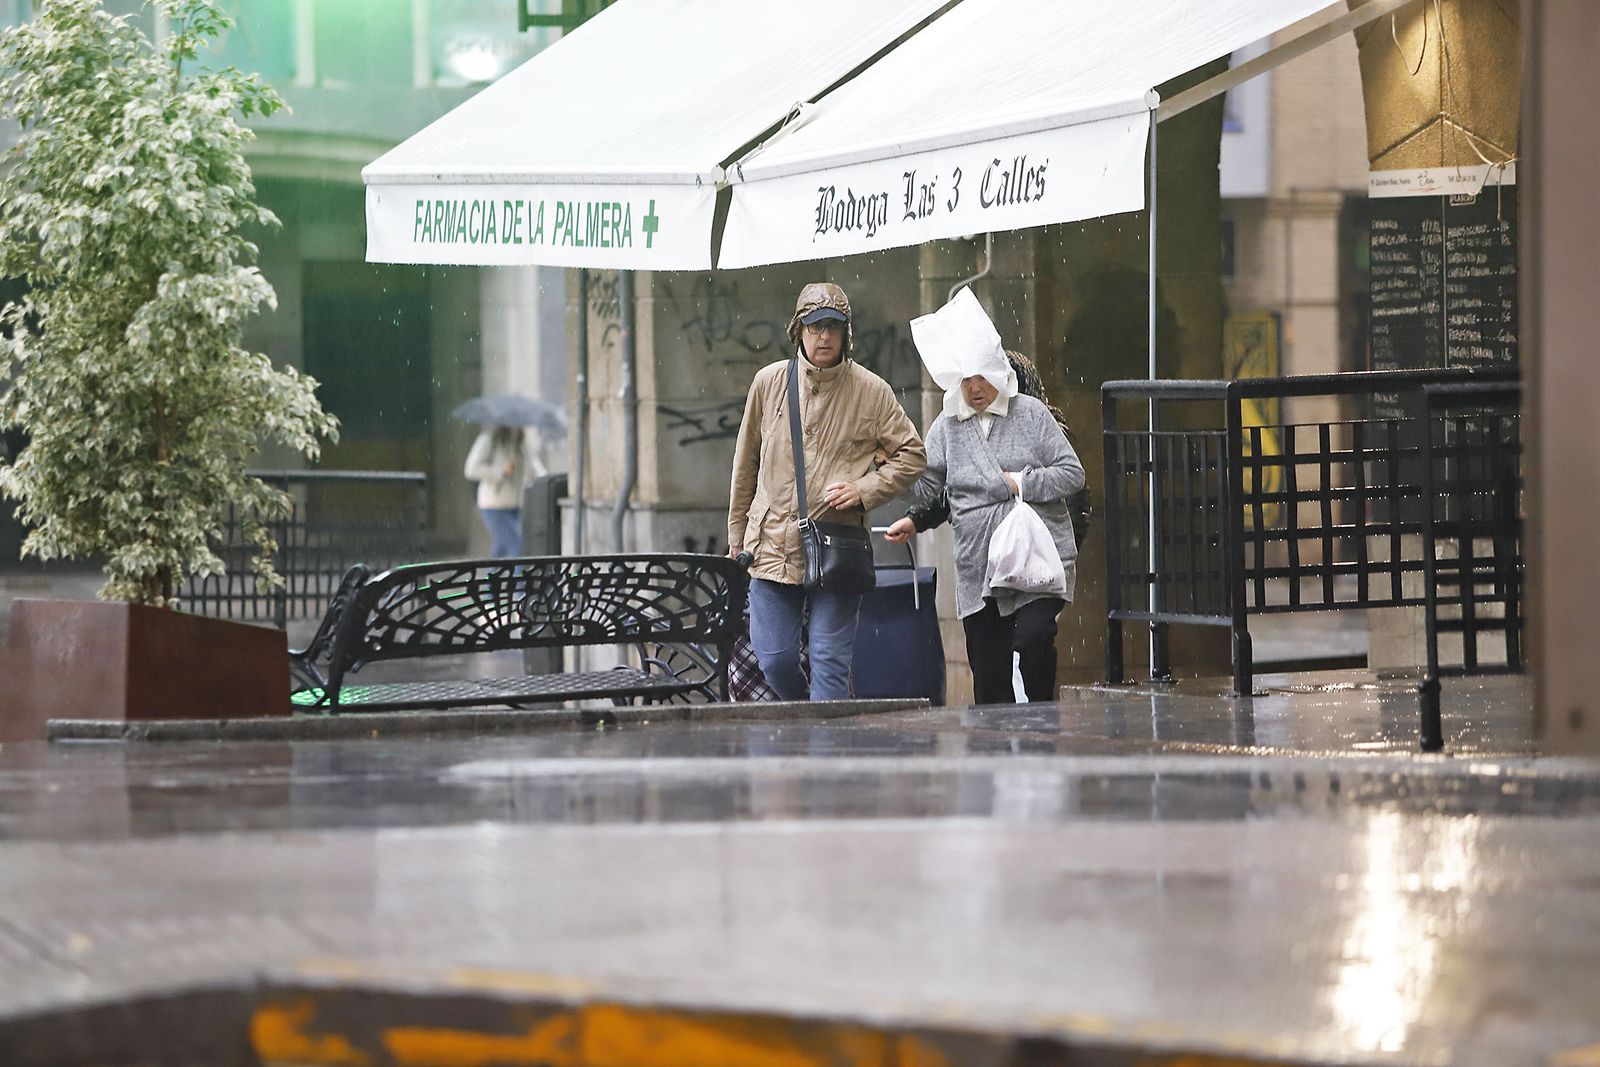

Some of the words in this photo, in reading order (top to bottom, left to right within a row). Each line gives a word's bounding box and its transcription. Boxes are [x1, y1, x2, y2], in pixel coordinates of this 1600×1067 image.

[413, 199, 497, 244] FARMACIA
[502, 200, 524, 245] DE
[528, 200, 545, 245] LA
[552, 200, 633, 248] PALMERA
[812, 185, 889, 243] Bodega
[902, 170, 938, 223] Las
[947, 166, 963, 213] 3
[979, 154, 1049, 209] Calles
